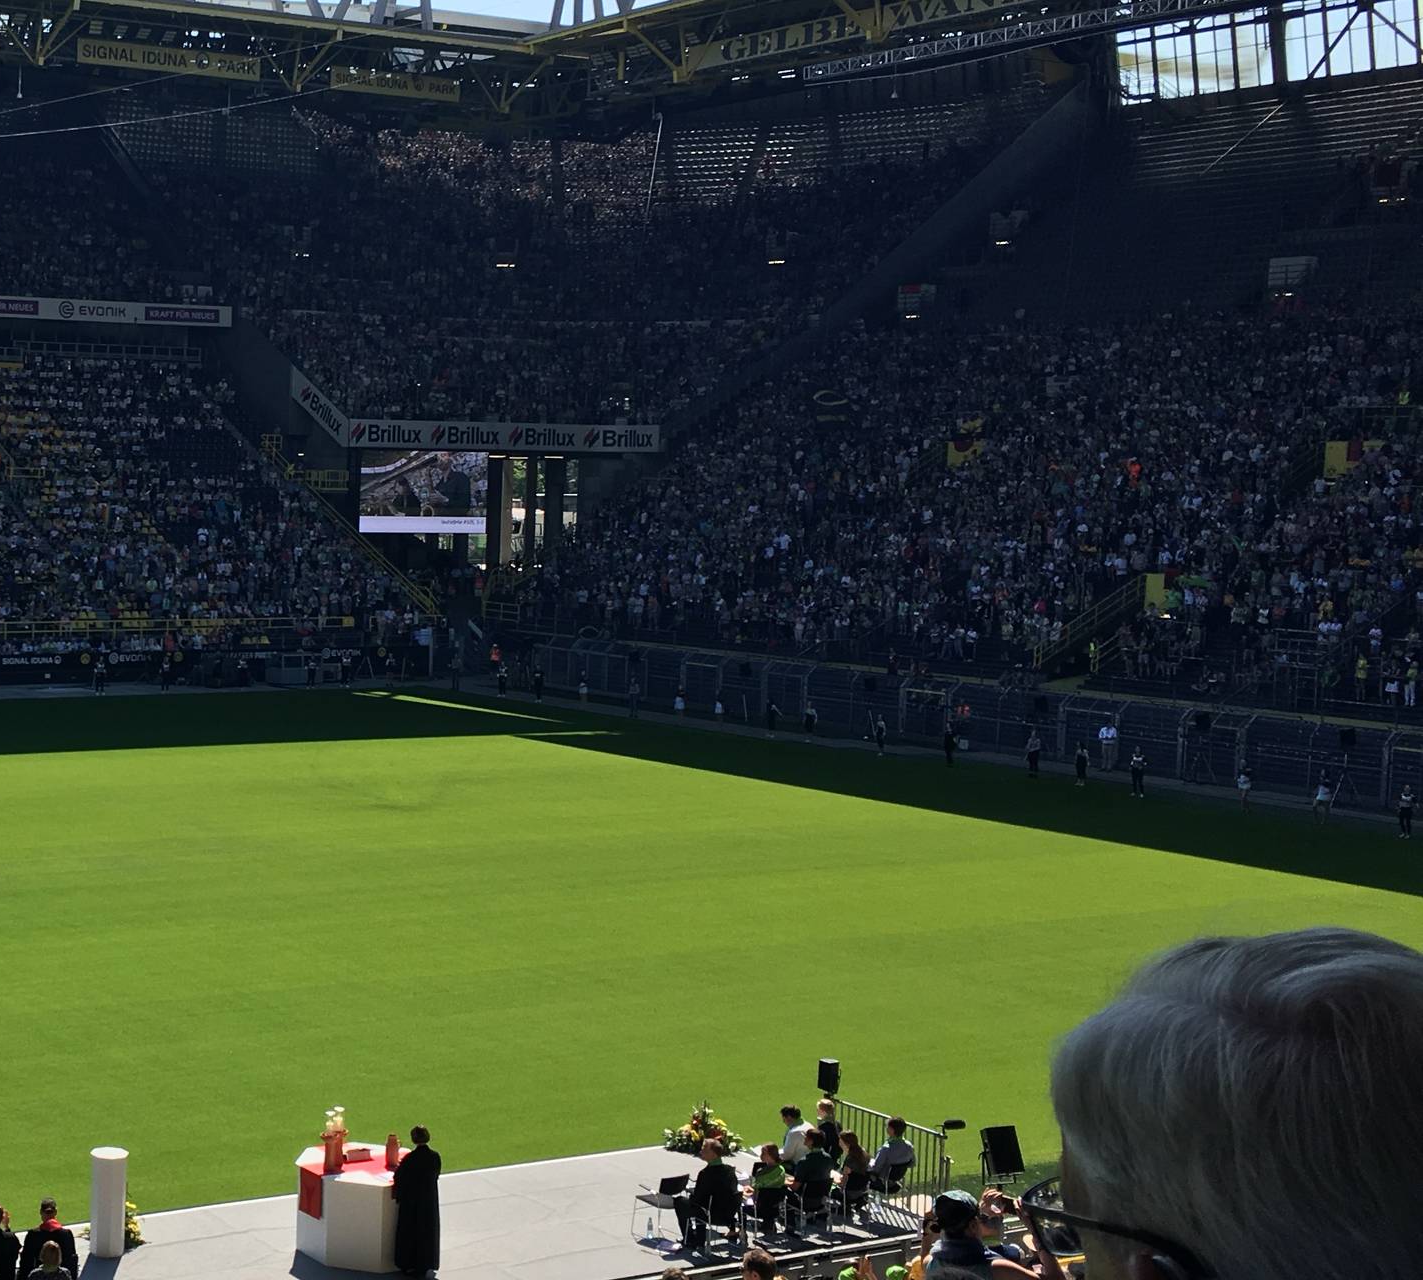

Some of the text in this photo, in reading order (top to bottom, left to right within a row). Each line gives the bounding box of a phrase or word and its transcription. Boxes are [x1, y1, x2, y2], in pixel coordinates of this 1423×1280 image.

[721, 16, 861, 60] GELBE
[82, 44, 257, 75] SIGNAL IDUNA PARK
[377, 78, 409, 91] IDUNA
[429, 83, 456, 95] PARK
[9, 303, 34, 312] NEUES
[79, 305, 126, 318] EVONIK
[149, 310, 175, 320] KRAFT
[308, 393, 343, 437] Brillux
[367, 424, 422, 444] Brillux
[447, 426, 499, 445] Brillux
[524, 428, 575, 447] Brillux
[602, 429, 653, 448] Brillux
[2, 657, 29, 665] SIGNAL
